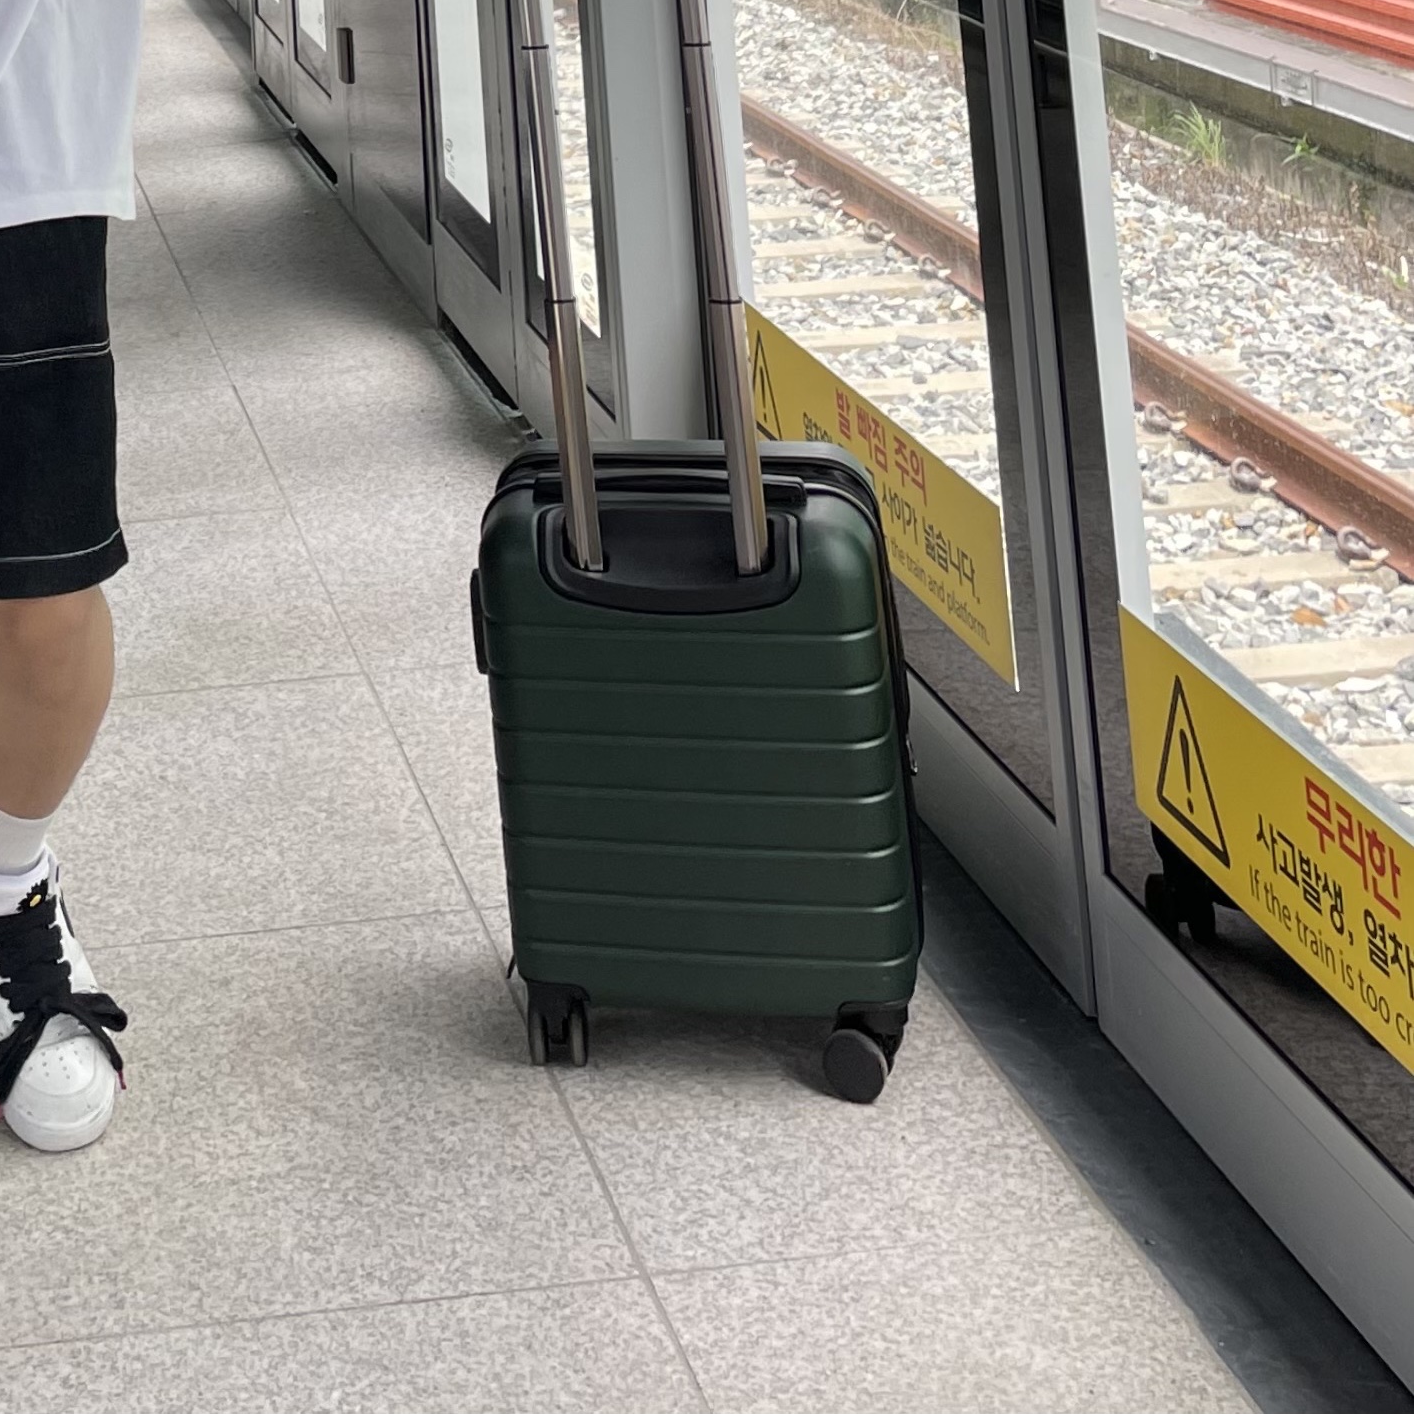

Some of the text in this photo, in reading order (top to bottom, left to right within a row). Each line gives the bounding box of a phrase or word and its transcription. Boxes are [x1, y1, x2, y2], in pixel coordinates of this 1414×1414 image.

[836, 388, 851, 441] 발
[856, 404, 888, 474] 빠짐
[894, 436, 927, 506] 주의
[882, 481, 918, 545] 사이가
[922, 516, 980, 604] 넓습니다.
[890, 536, 906, 566] the
[906, 553, 926, 584] train
[928, 574, 945, 604] and
[1256, 813, 1354, 947] 사고발생,
[1304, 776, 1402, 921] 무리한
[1248, 864, 1260, 902] If
[1263, 881, 1291, 931] the
[1295, 910, 1337, 974] train
[1339, 949, 1355, 991] is
[1358, 969, 1390, 1025] too
